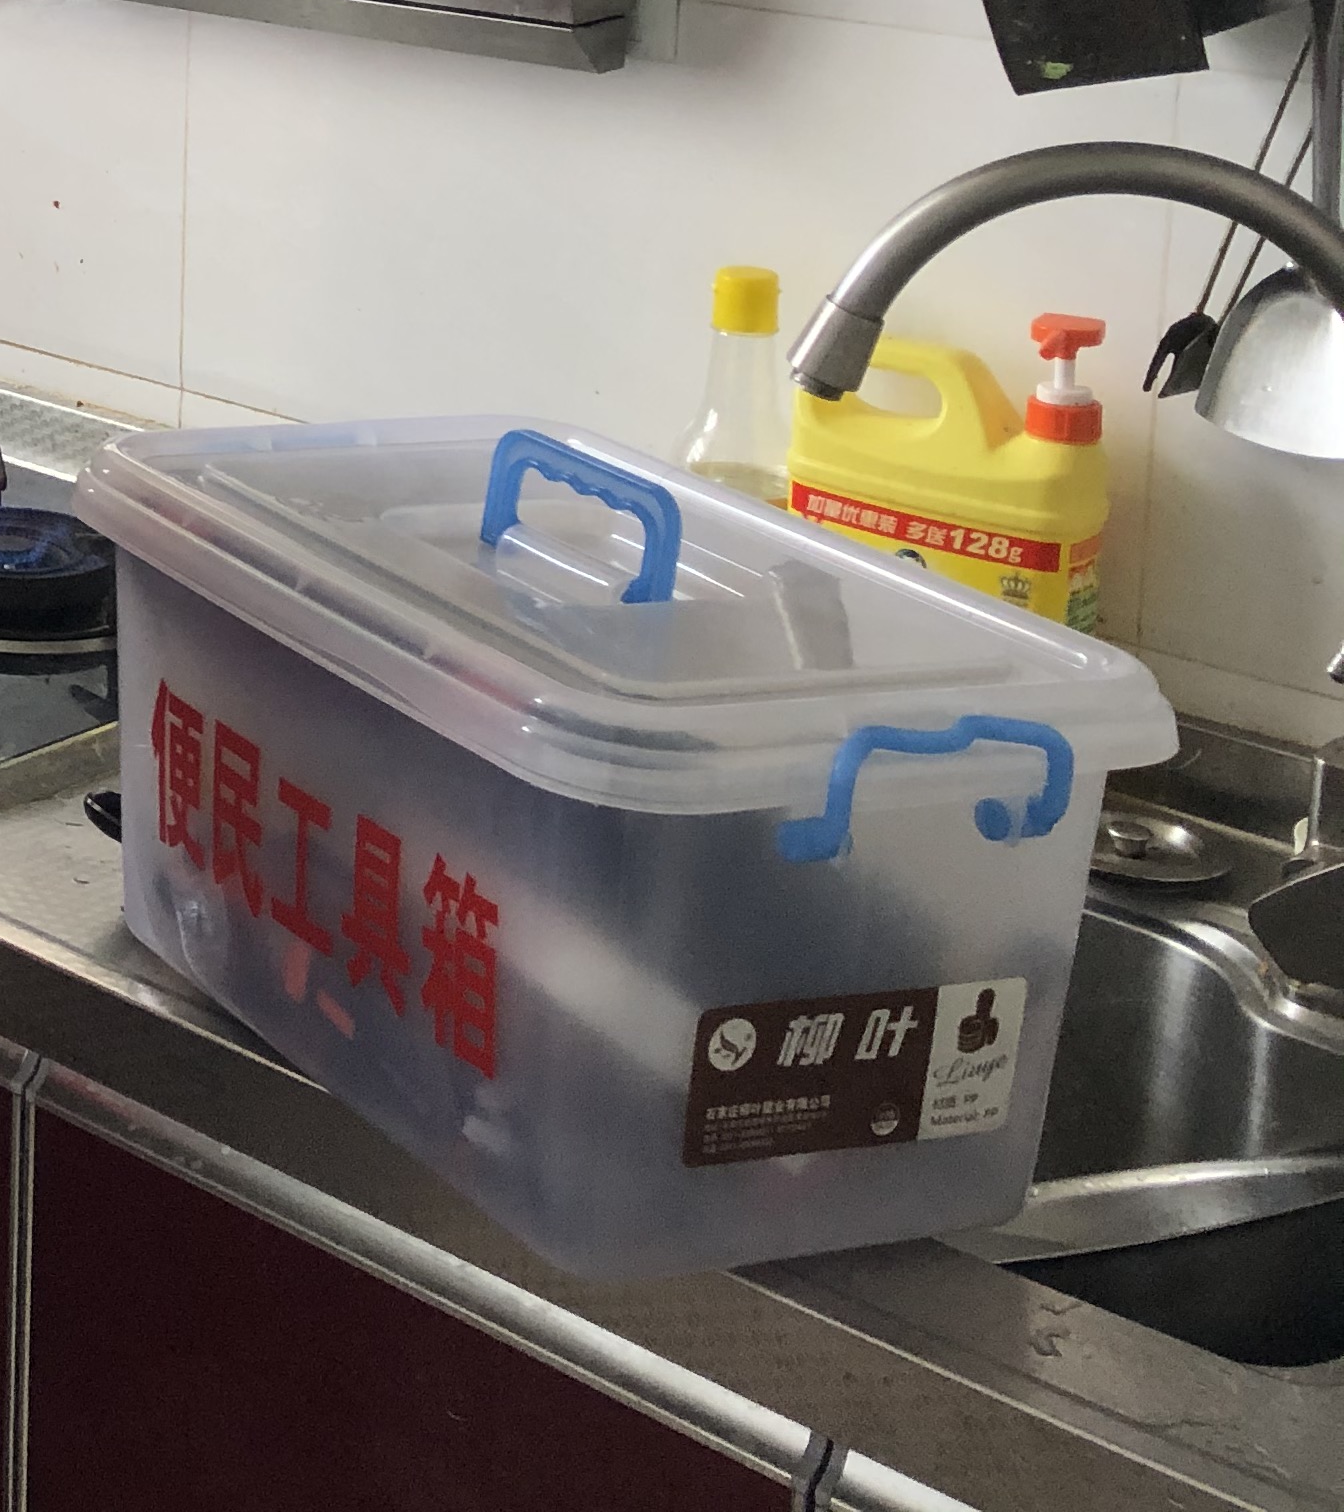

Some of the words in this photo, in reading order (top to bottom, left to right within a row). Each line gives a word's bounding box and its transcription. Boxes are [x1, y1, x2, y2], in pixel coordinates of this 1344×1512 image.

[150, 677, 500, 1081] 便民工具箱
